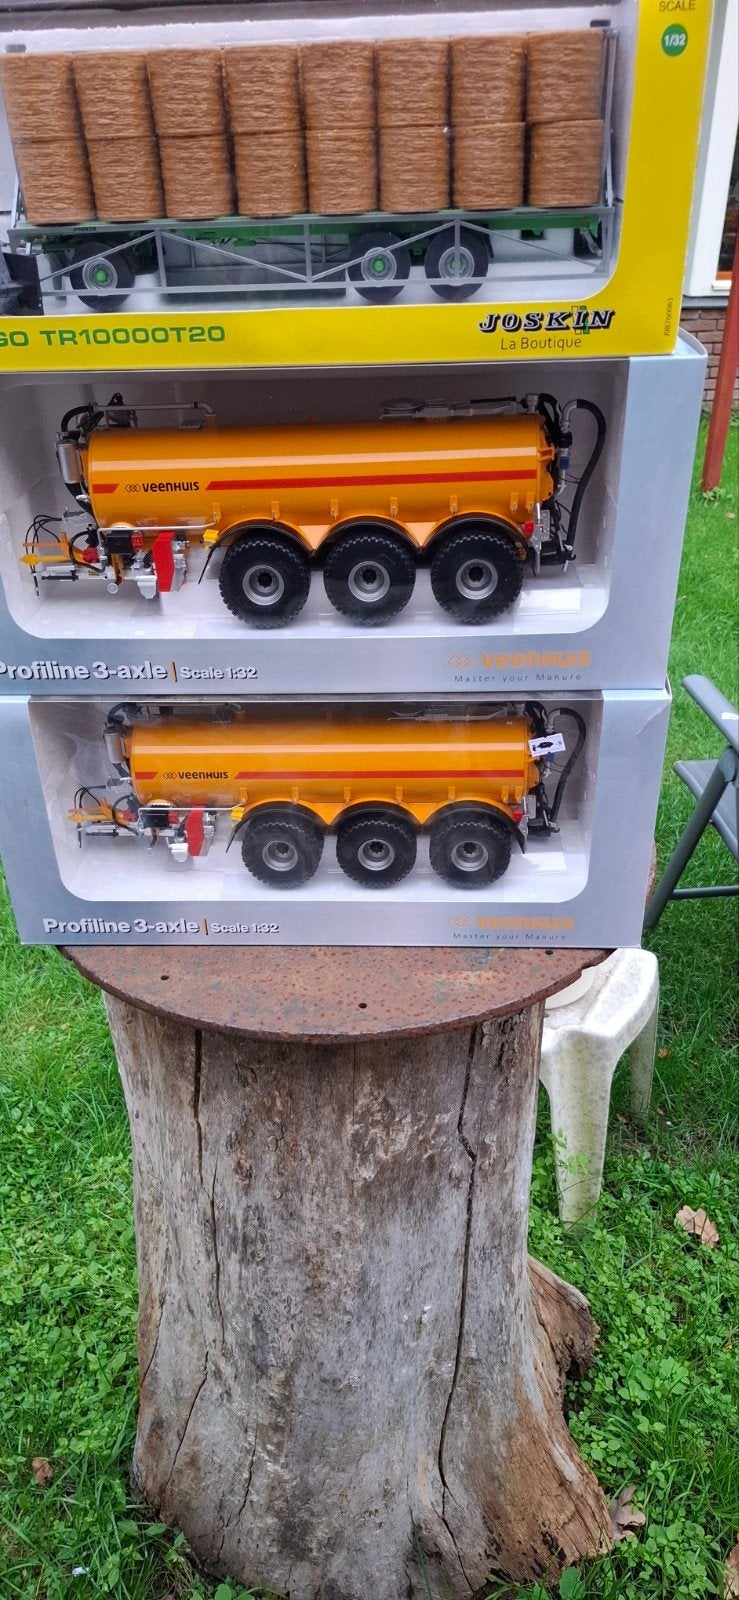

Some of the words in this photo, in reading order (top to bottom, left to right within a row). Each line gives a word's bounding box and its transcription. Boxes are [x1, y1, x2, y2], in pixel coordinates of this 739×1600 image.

[659, 0, 696, 12] SCALE
[664, 34, 687, 47] 1/32
[478, 309, 616, 333] JOSKIN
[39, 325, 226, 346] TR10000T20
[501, 338, 517, 350] La
[521, 337, 582, 352] Boutique
[92, 660, 168, 680] 3-axle
[180, 667, 224, 680] Scale
[225, 667, 258, 679] 1:32
[502, 675, 529, 683] your
[536, 674, 582, 682] Manure
[42, 918, 132, 934] Profiline
[134, 918, 201, 934] 3-axle
[211, 922, 250, 935] Scale
[250, 923, 280, 934] 1:32
